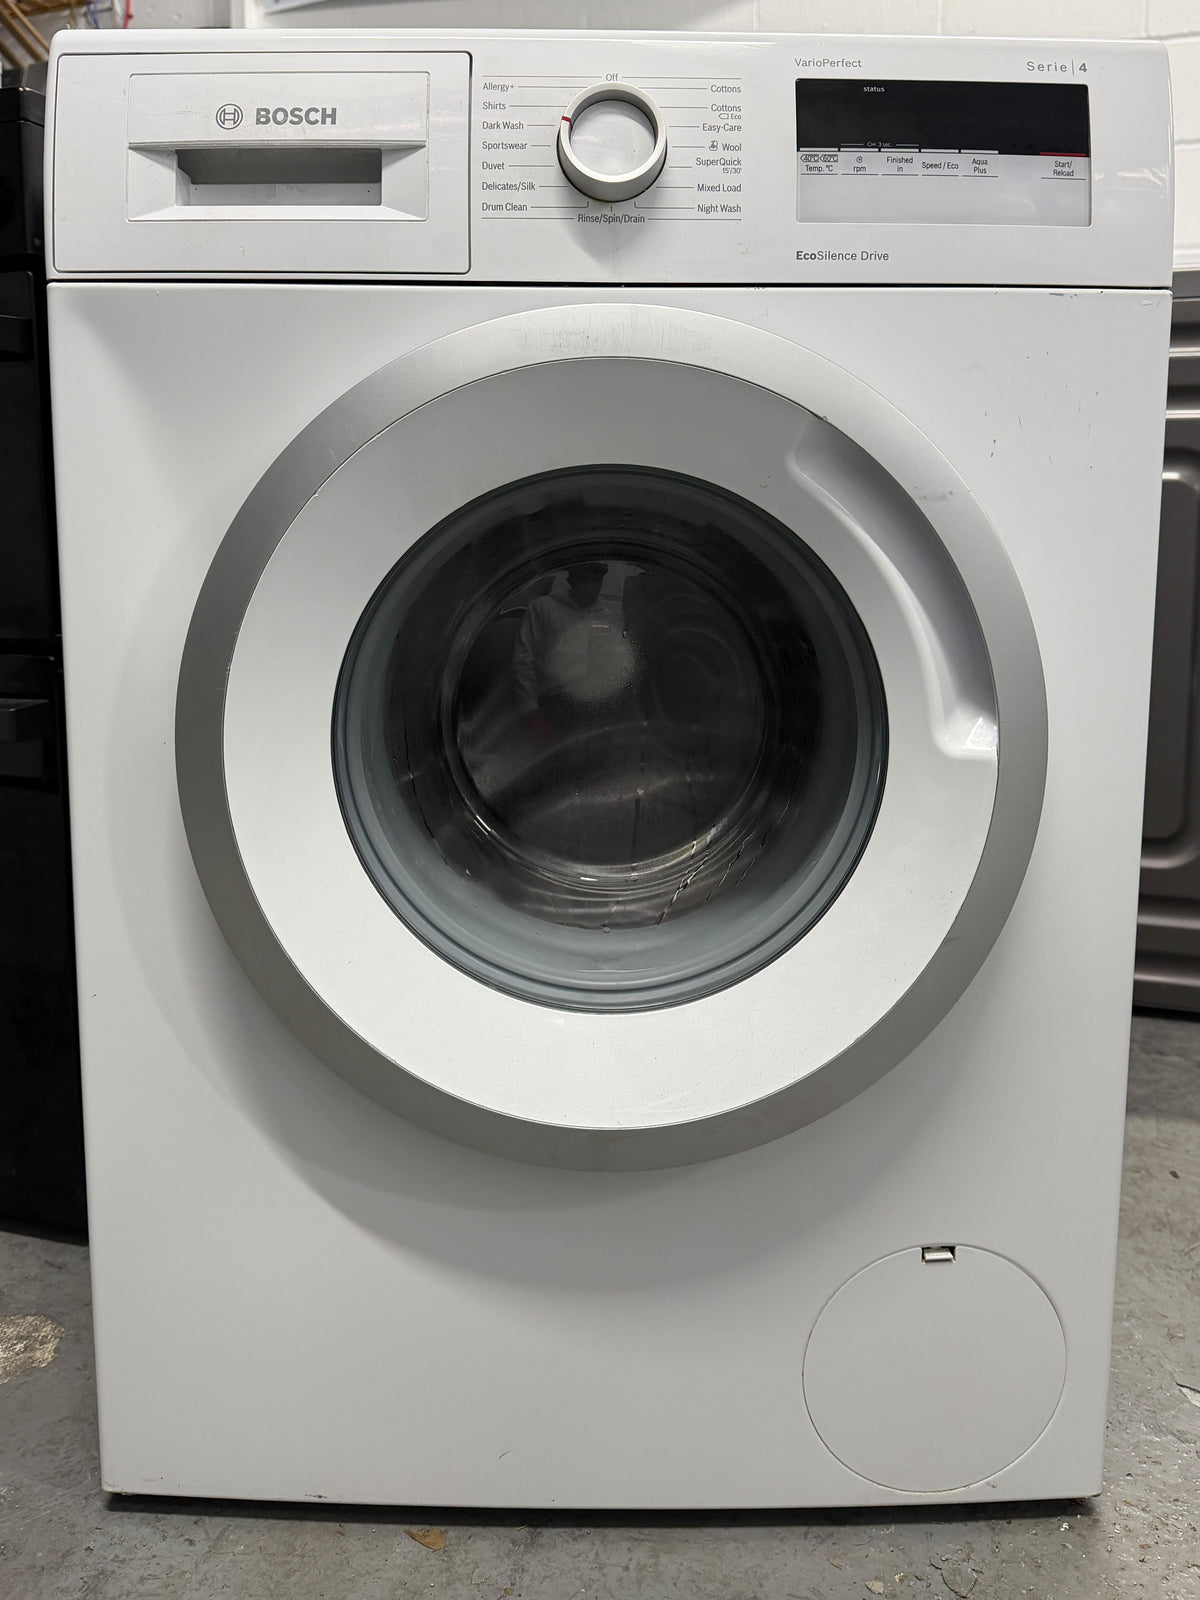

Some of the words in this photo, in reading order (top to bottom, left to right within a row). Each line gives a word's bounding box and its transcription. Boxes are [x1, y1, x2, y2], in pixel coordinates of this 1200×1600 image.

[795, 58, 862, 68] VarioPerfect
[1026, 61, 1067, 72] Serie
[606, 74, 618, 82] Off
[482, 83, 514, 92] Allergy+
[482, 102, 506, 110] Shirts
[711, 104, 742, 112] Cottons
[256, 108, 337, 126] BOSCH
[482, 121, 500, 130] Dark
[502, 121, 524, 130] Wash
[702, 123, 742, 132] Easy-Care
[482, 141, 528, 151] Sportswear
[722, 144, 742, 152] Wool
[482, 162, 504, 170] Duvet
[696, 157, 742, 167] SuperQuick
[922, 162, 942, 170] Speed
[972, 158, 988, 166] Aqua
[482, 182, 536, 191] Delicates/Silk
[697, 184, 720, 192] Mixed
[722, 184, 742, 192] Load
[482, 202, 504, 211] Drum
[505, 202, 528, 211] Clean
[698, 204, 718, 214] Night
[720, 204, 742, 213] Wash
[578, 214, 645, 224] Rinse/Spin/Drain
[796, 251, 857, 260] EcoSilence
[860, 251, 889, 260] Drive
